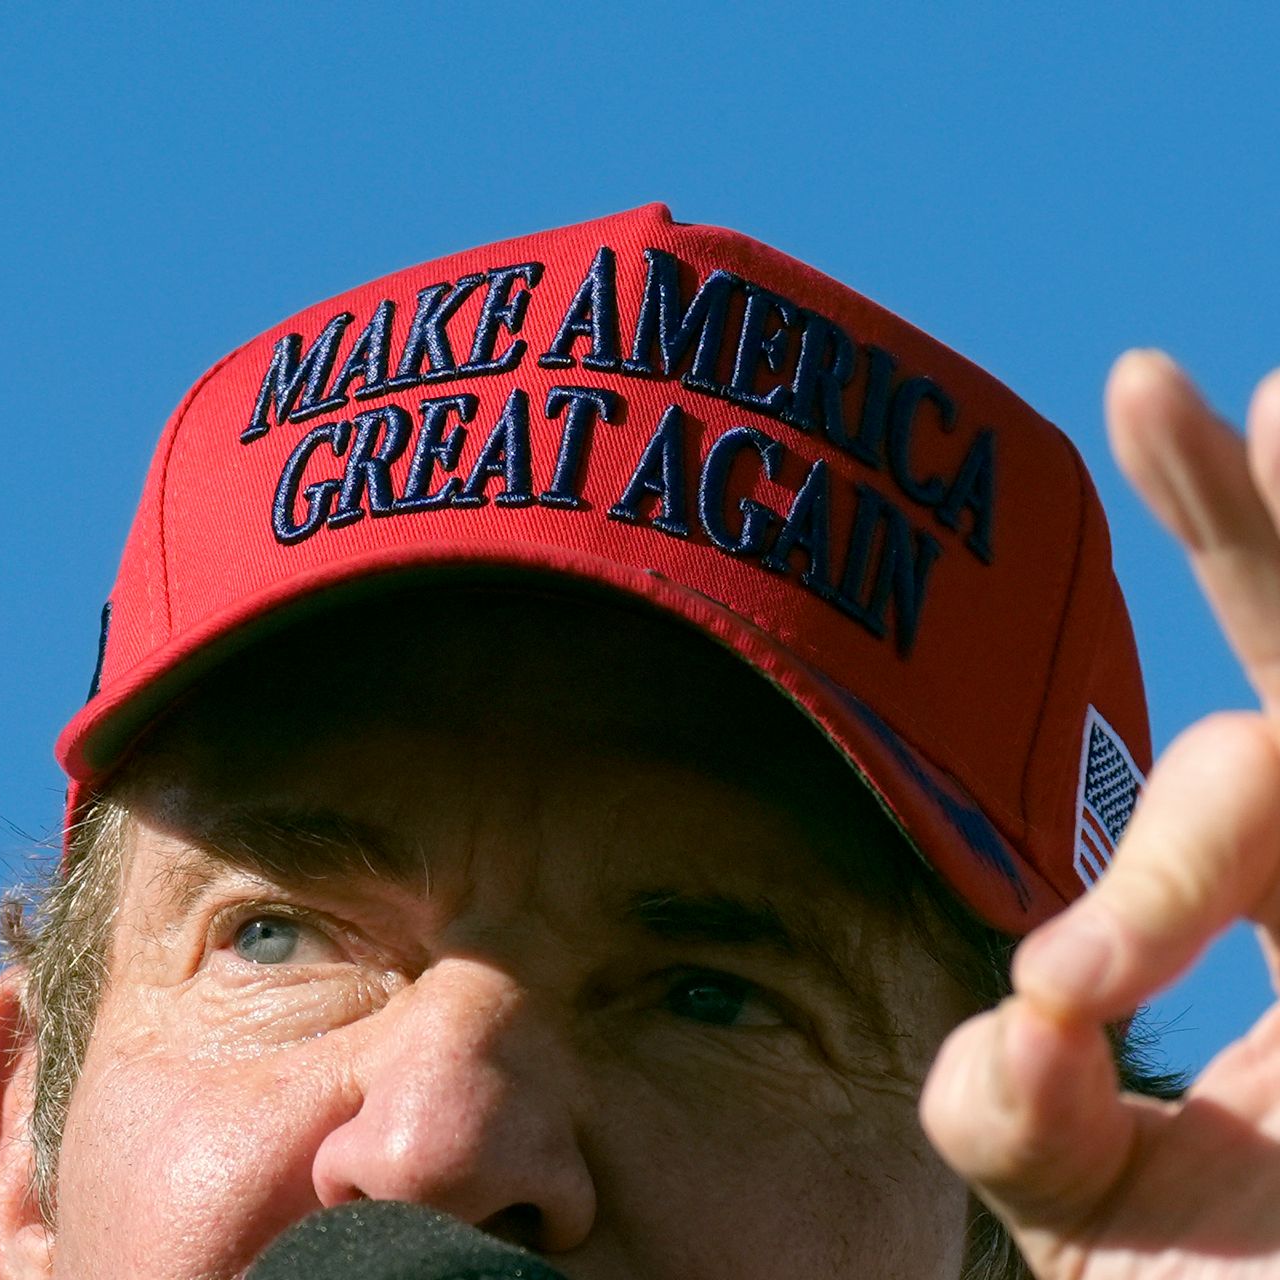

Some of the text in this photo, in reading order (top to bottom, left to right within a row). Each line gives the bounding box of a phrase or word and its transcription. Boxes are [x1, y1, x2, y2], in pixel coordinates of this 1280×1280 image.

[241, 246, 995, 565] MAKE AMERICA
[273, 386, 943, 659] GREAT AGAIN
